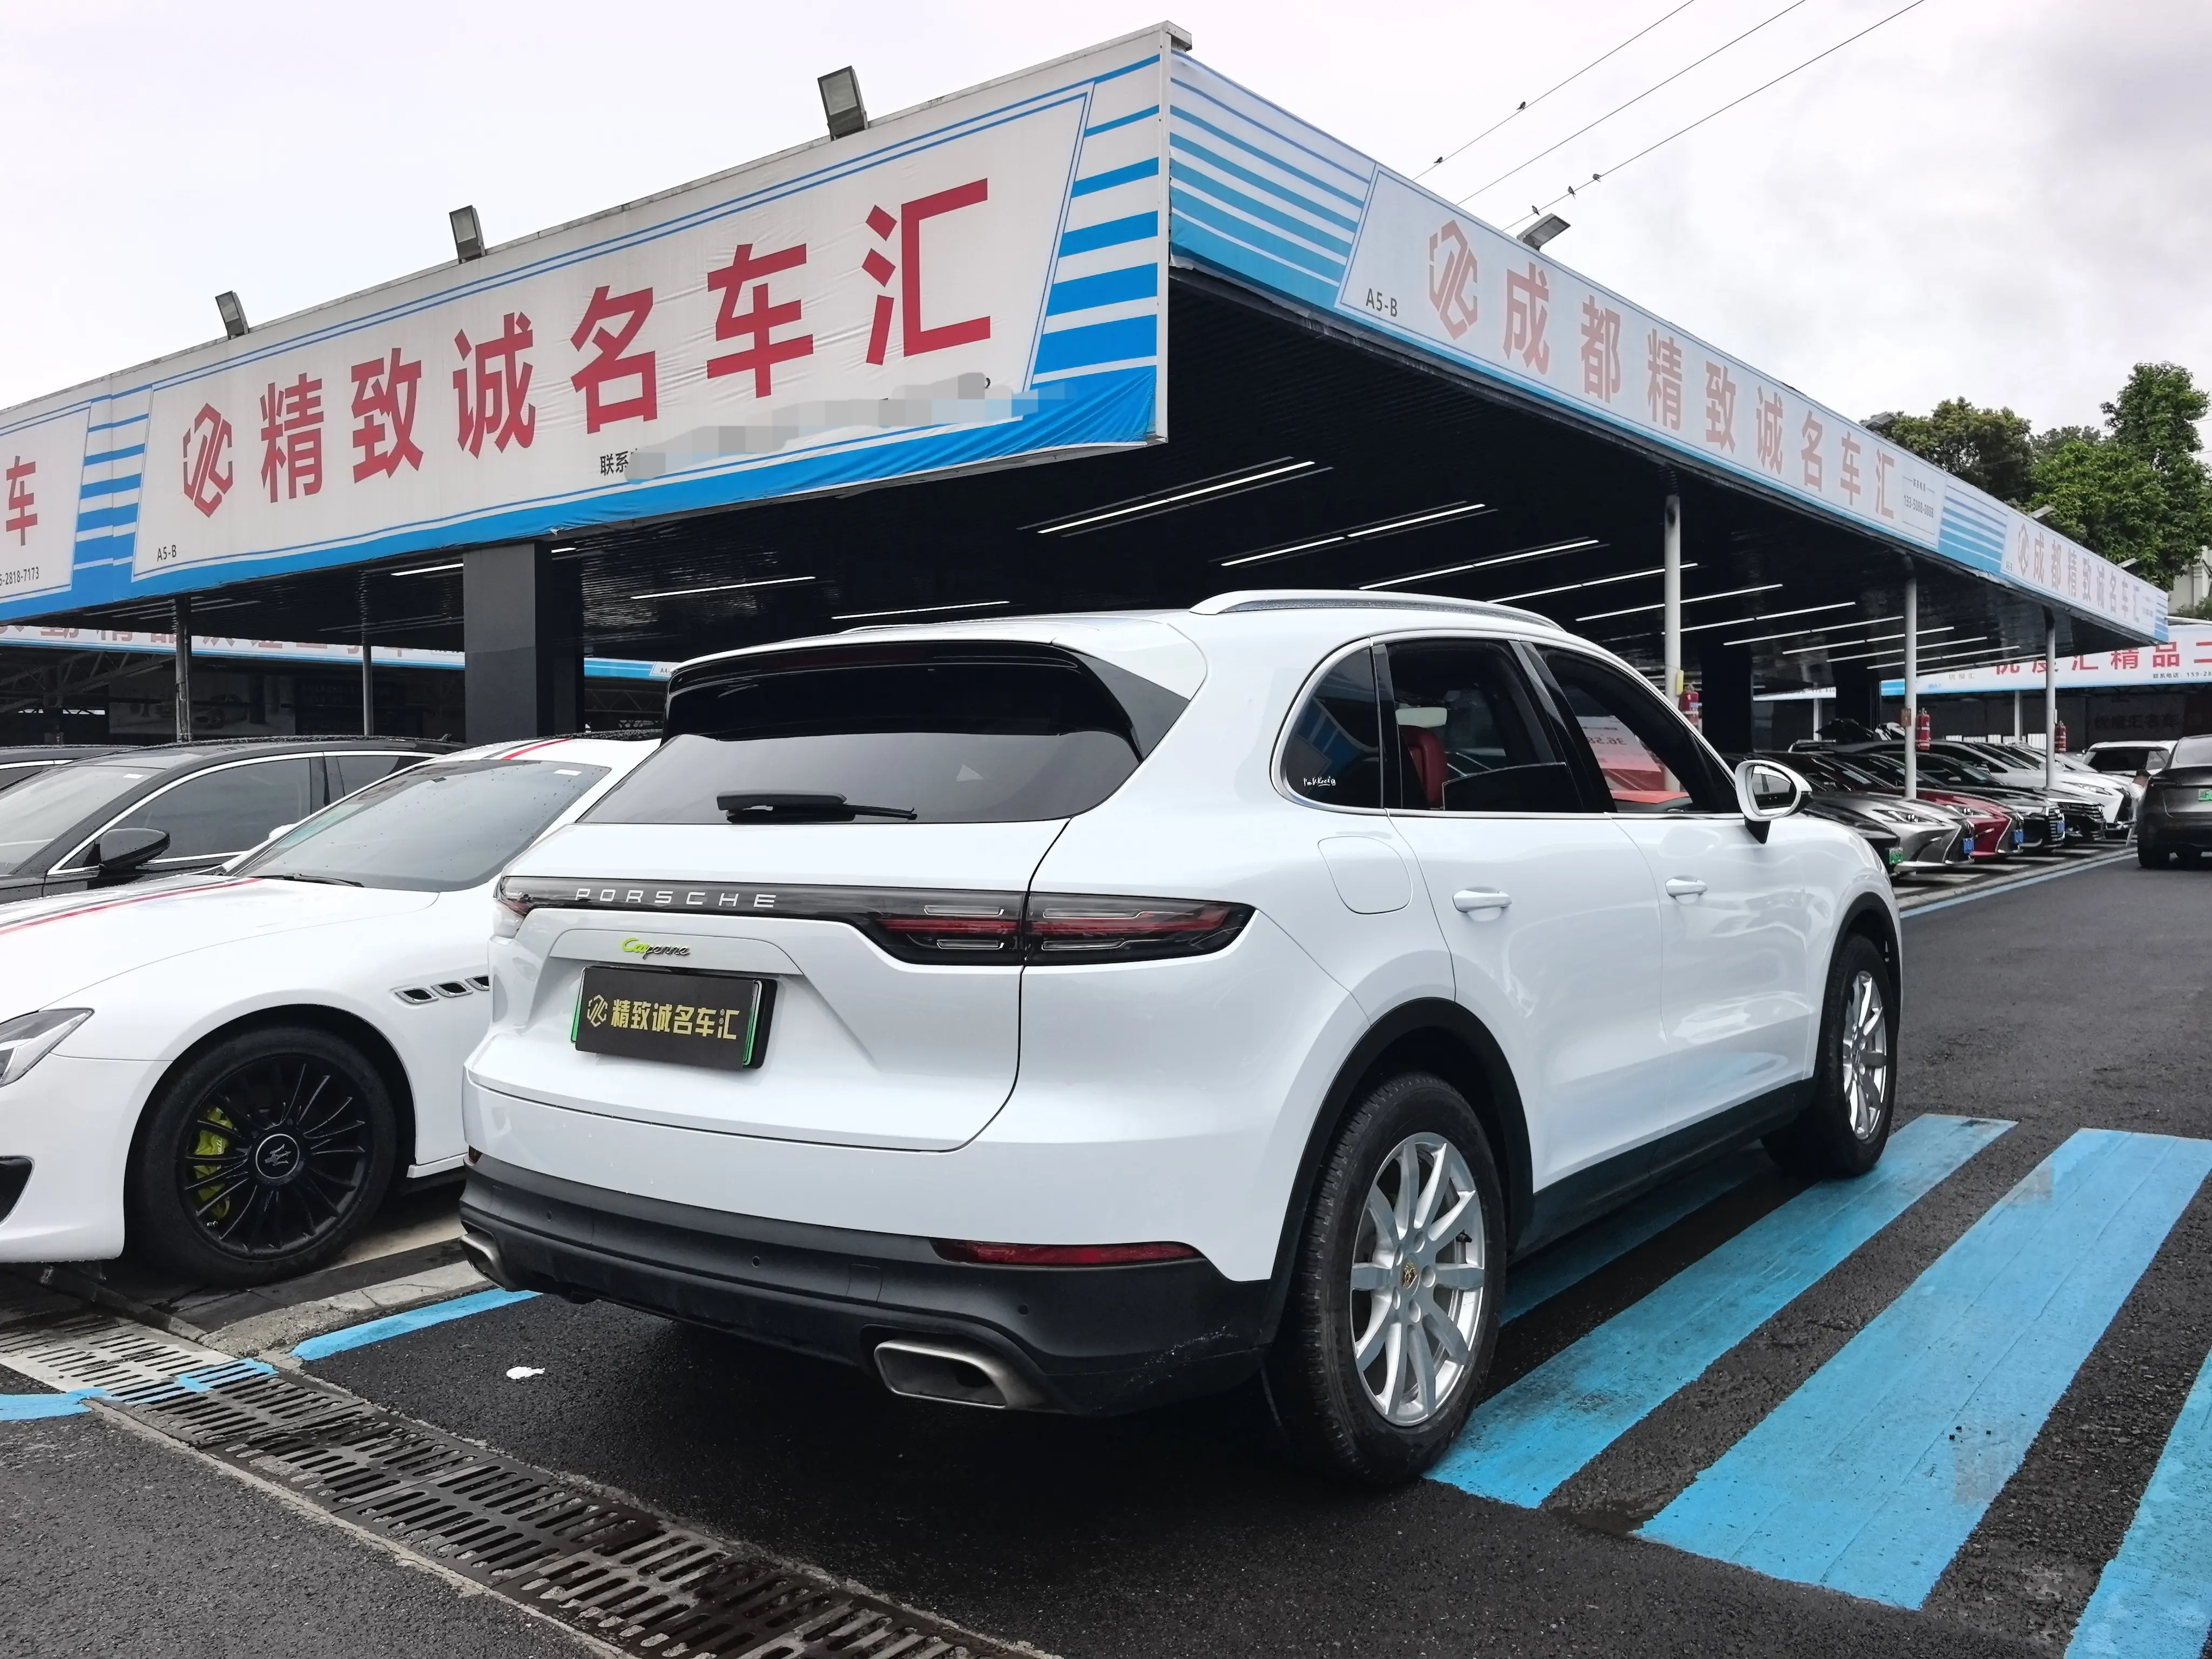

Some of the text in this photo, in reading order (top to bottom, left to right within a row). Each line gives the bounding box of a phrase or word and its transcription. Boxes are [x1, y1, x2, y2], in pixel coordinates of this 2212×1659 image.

[1365, 288, 1398, 318] A5-B
[261, 178, 990, 503] 精致诚名车汇
[1503, 261, 1894, 520] 成都精致诚名车汇
[6, 455, 38, 546] 车
[157, 544, 177, 562] A5-B
[575, 888, 777, 908] PORSCHE
[622, 937, 691, 960] Cayenne
[611, 999, 740, 1040] 精致诚名车汇
